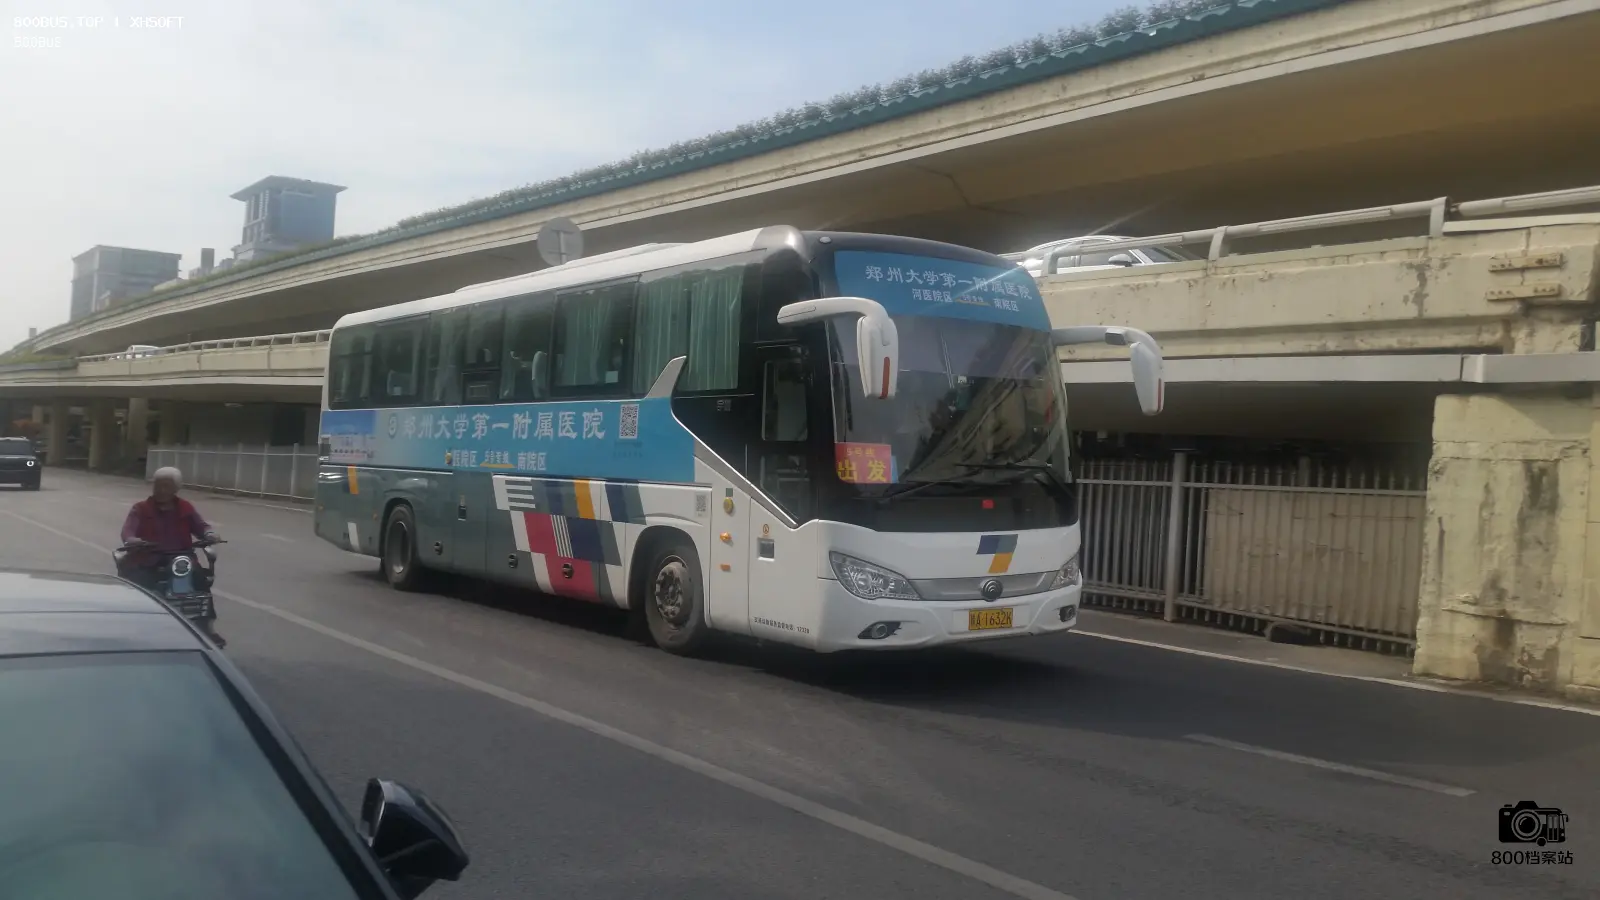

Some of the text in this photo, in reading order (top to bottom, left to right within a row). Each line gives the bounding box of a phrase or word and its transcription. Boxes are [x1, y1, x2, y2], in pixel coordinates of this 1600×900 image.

[865, 265, 1032, 300] 郑州大学第一附属医院
[401, 408, 606, 440] 郑州大学第一附属医院
[445, 449, 478, 468] 医院区
[517, 451, 547, 471] 南院区
